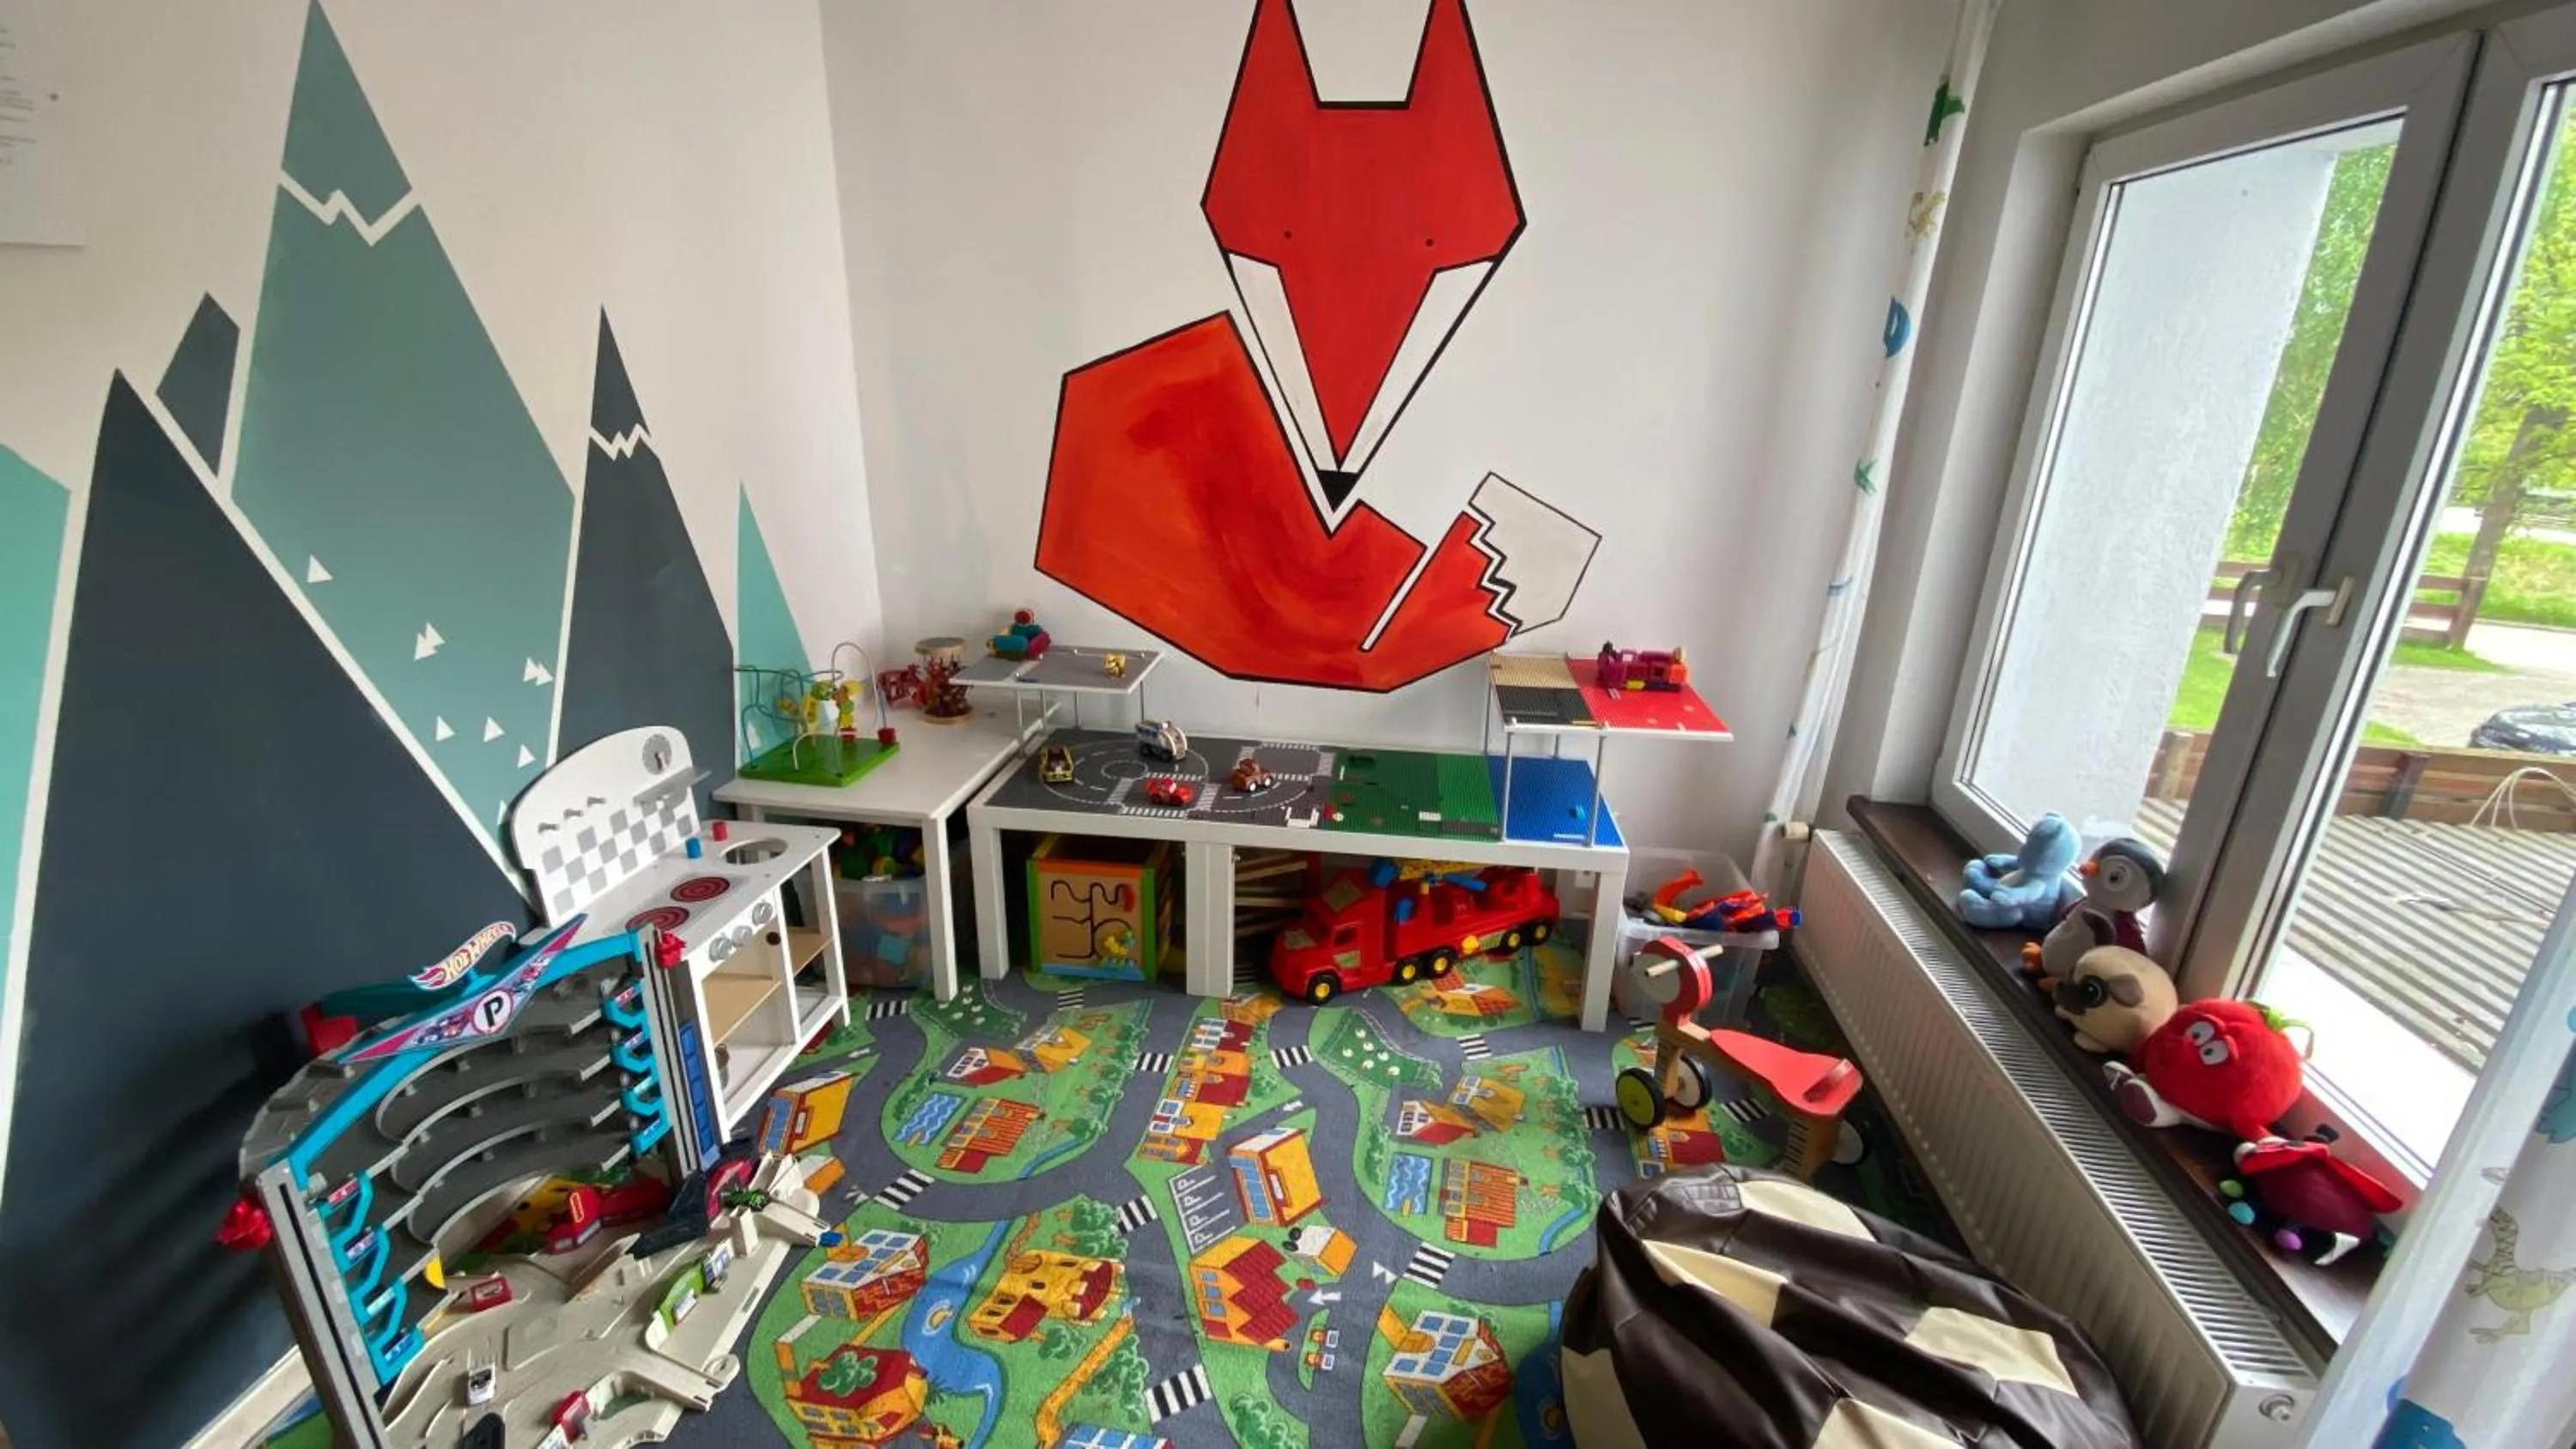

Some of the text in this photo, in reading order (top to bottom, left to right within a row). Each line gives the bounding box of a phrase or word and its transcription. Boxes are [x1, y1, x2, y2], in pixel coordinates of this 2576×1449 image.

[483, 996, 504, 1028] P
[1176, 1179, 1196, 1191] P
[1183, 1196, 1202, 1207] P
[1189, 1215, 1209, 1227] P
[1194, 1233, 1214, 1246] P
